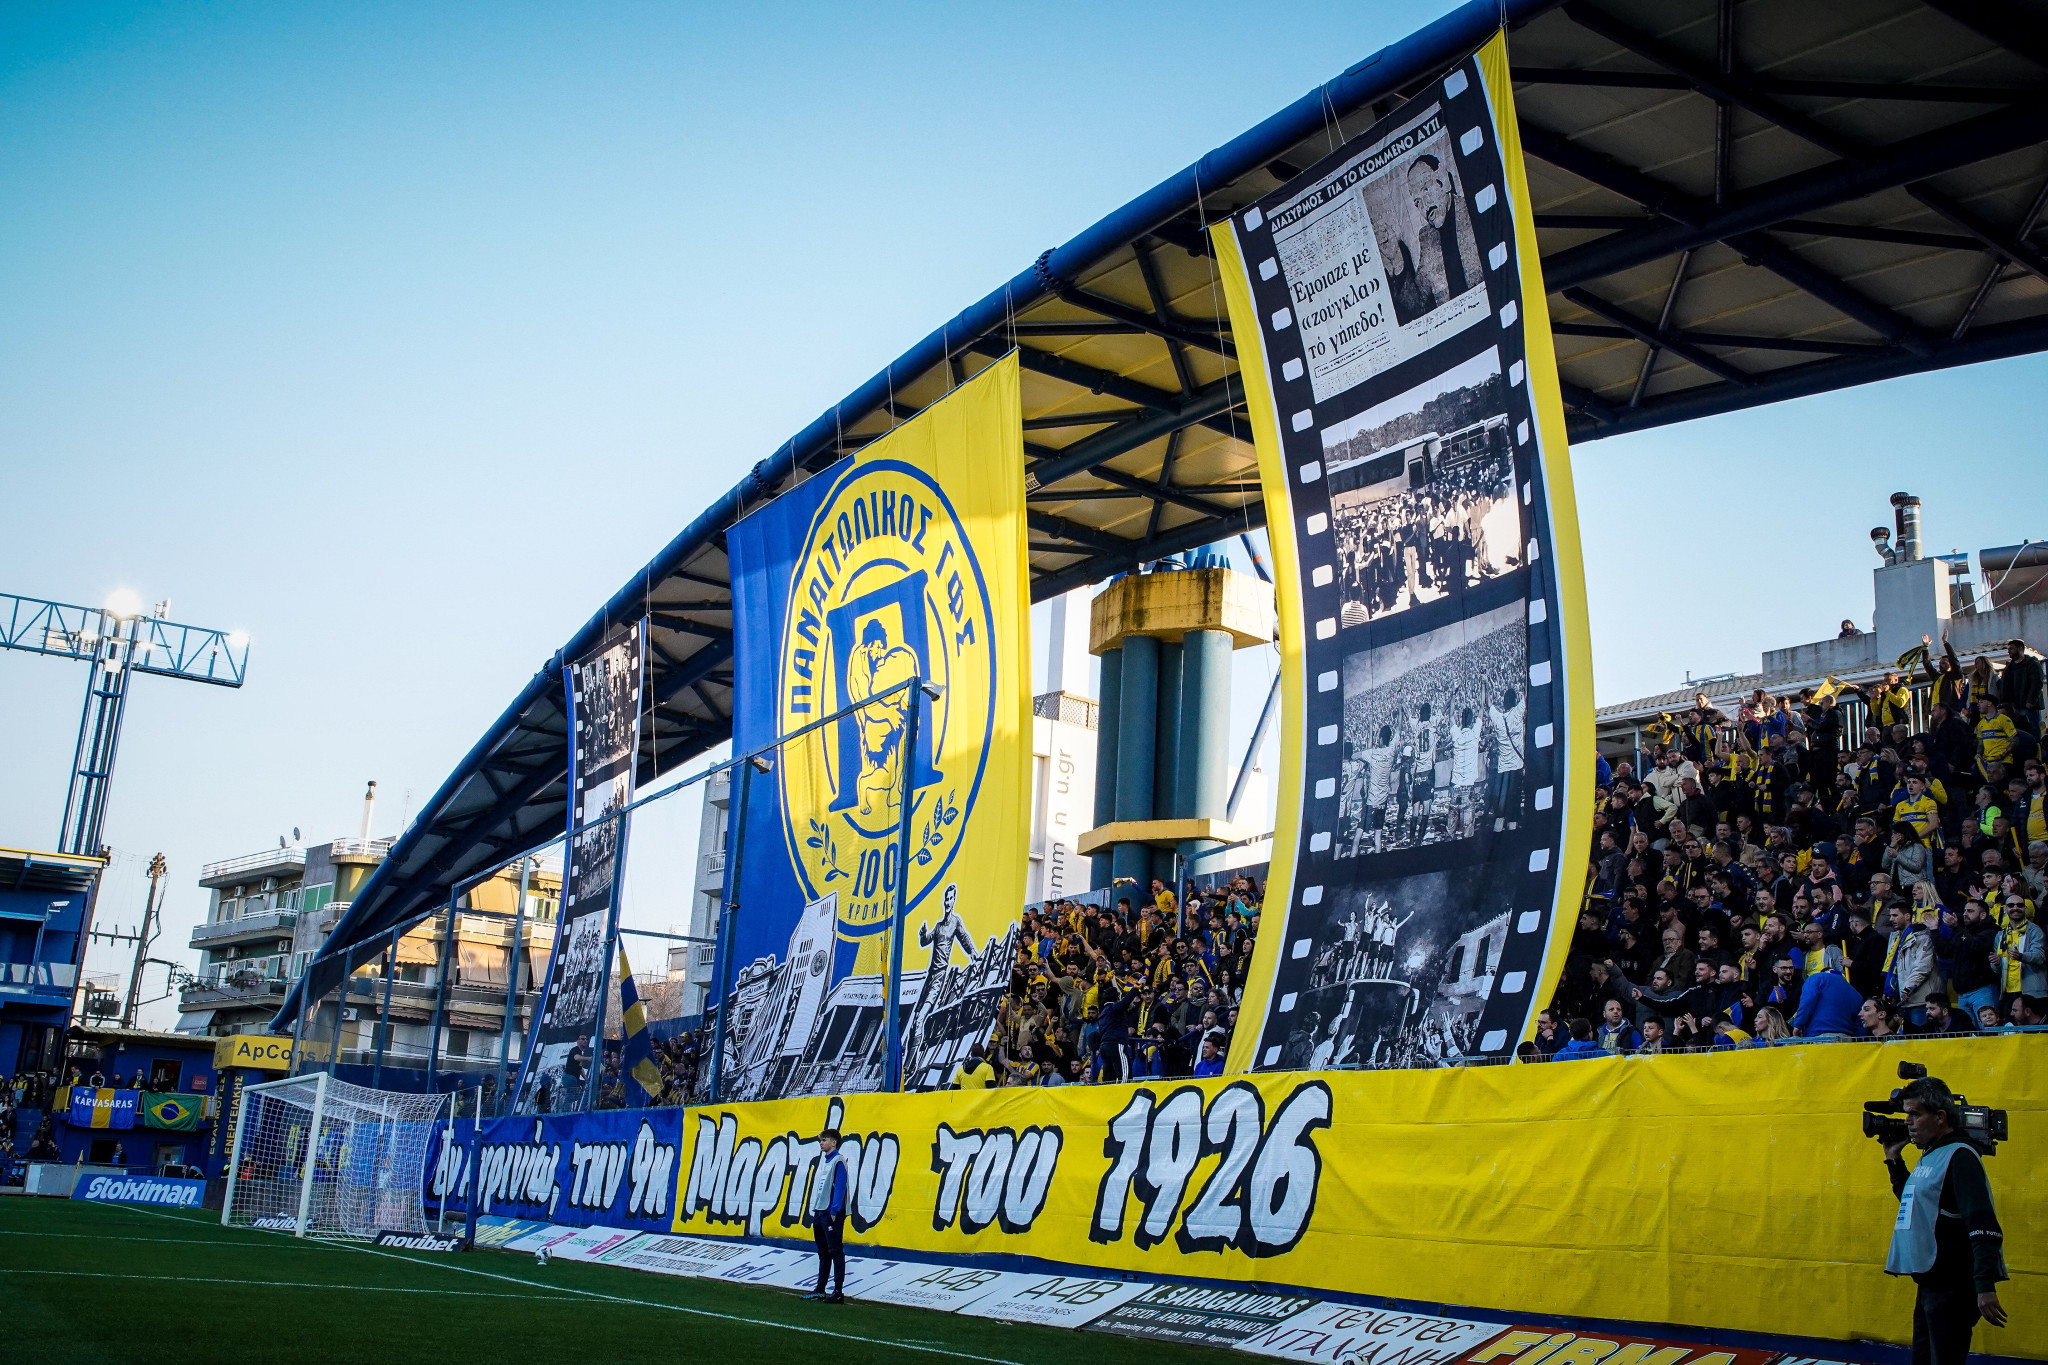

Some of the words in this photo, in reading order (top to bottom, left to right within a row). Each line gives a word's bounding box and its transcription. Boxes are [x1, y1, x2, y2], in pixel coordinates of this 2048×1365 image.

[1271, 191, 1324, 233] ΔΙΑΣΥΡΜΟΣ
[1327, 182, 1343, 198] ΓΙΑ
[1343, 169, 1358, 187] ΤΟ
[1359, 135, 1414, 178] ΚΟΜΜΕΝΟ
[1417, 116, 1441, 142] ΑΥΤΙ
[791, 490, 932, 713] ΠΑΝΑΙΤΩΛΙΚΟΣ
[852, 842, 898, 898] 100
[75, 1096, 133, 1109] KARVASARAS
[224, 1075, 244, 1154] ΕΝΕΡΓΕΙΑΚΗΣ
[569, 1138, 628, 1208] την
[931, 1122, 1064, 1235] του
[1088, 1080, 1333, 1258] 1926
[1911, 1166, 1933, 1178] REW
[85, 1177, 198, 1205] Stoiximan
[253, 1217, 313, 1230] novibt
[380, 1234, 459, 1251] novibet
[1157, 1286, 1310, 1318] SARAGANIDAS
